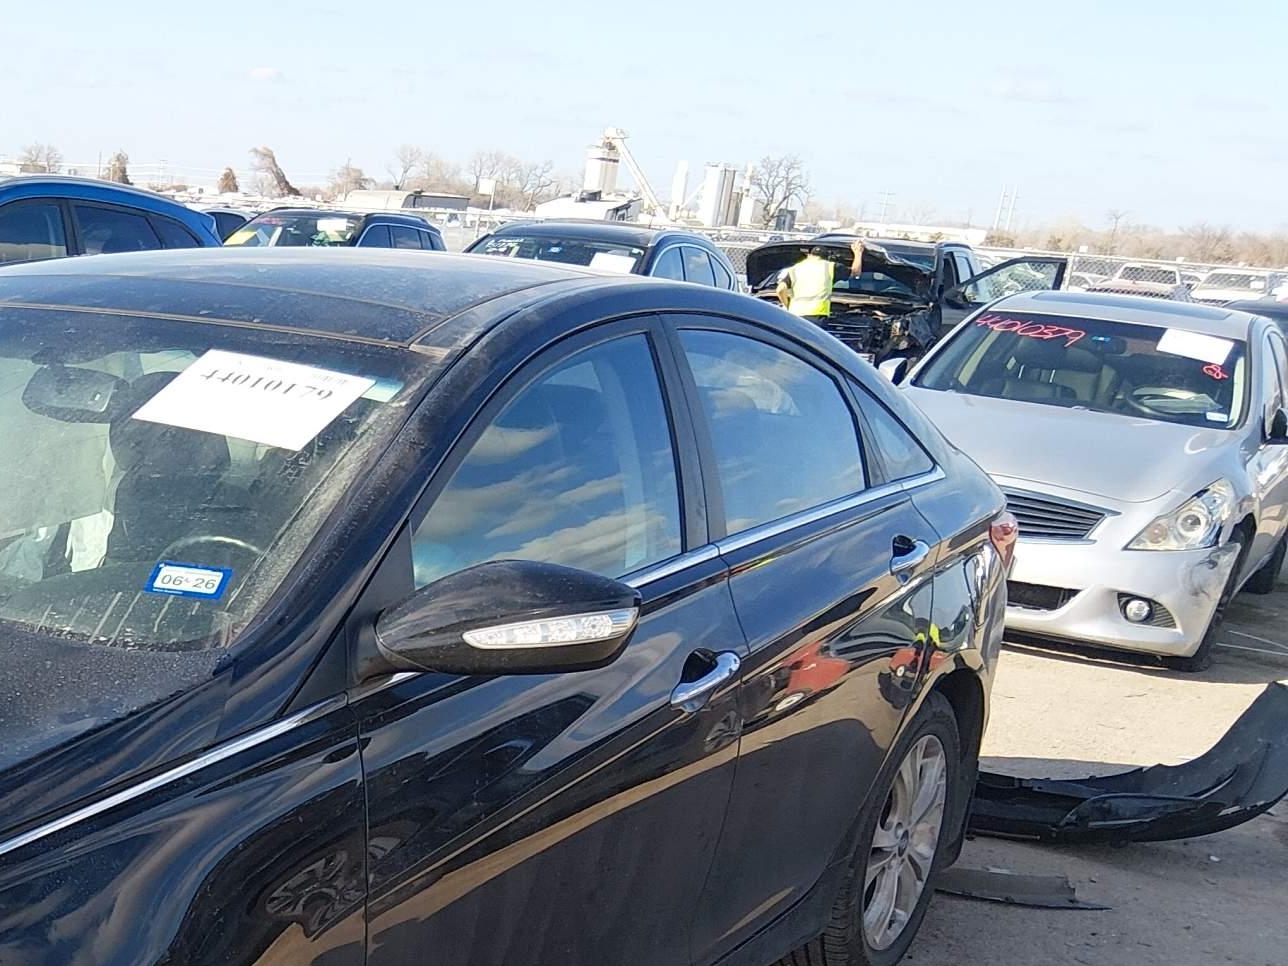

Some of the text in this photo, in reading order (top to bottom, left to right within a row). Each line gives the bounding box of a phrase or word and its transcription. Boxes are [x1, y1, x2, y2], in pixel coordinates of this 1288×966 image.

[200, 369, 334, 400] 44010179
[161, 574, 217, 590] 06 26
